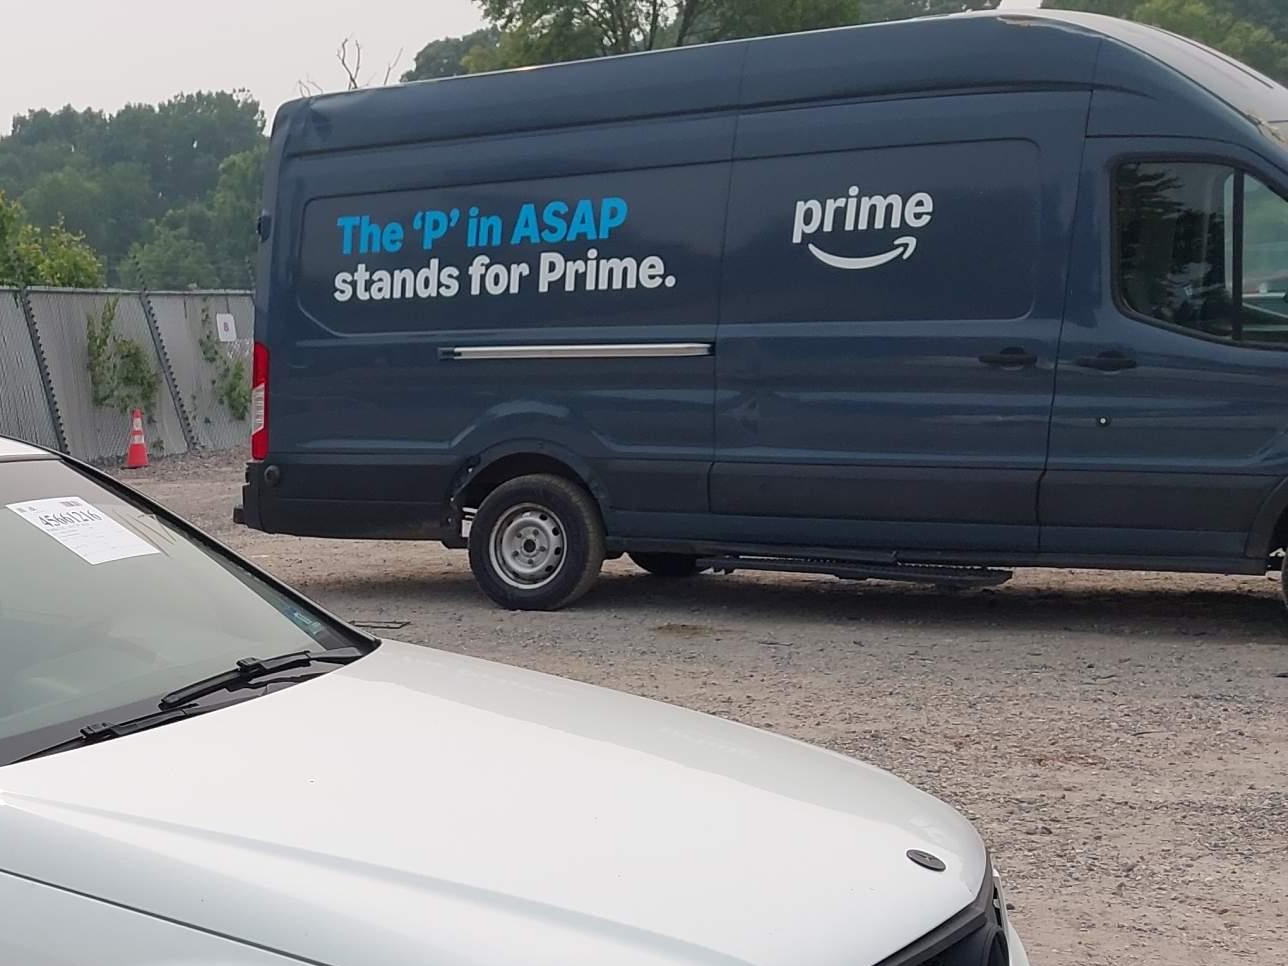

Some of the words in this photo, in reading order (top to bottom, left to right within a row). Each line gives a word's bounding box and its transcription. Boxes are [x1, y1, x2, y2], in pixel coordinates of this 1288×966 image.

[337, 215, 404, 254] The
[467, 206, 503, 247] in
[510, 197, 628, 244] ASAP
[792, 185, 934, 244] prime
[333, 258, 460, 301] stands
[468, 254, 530, 296] for
[538, 248, 676, 293] Prime.
[38, 509, 103, 527] 45661216
